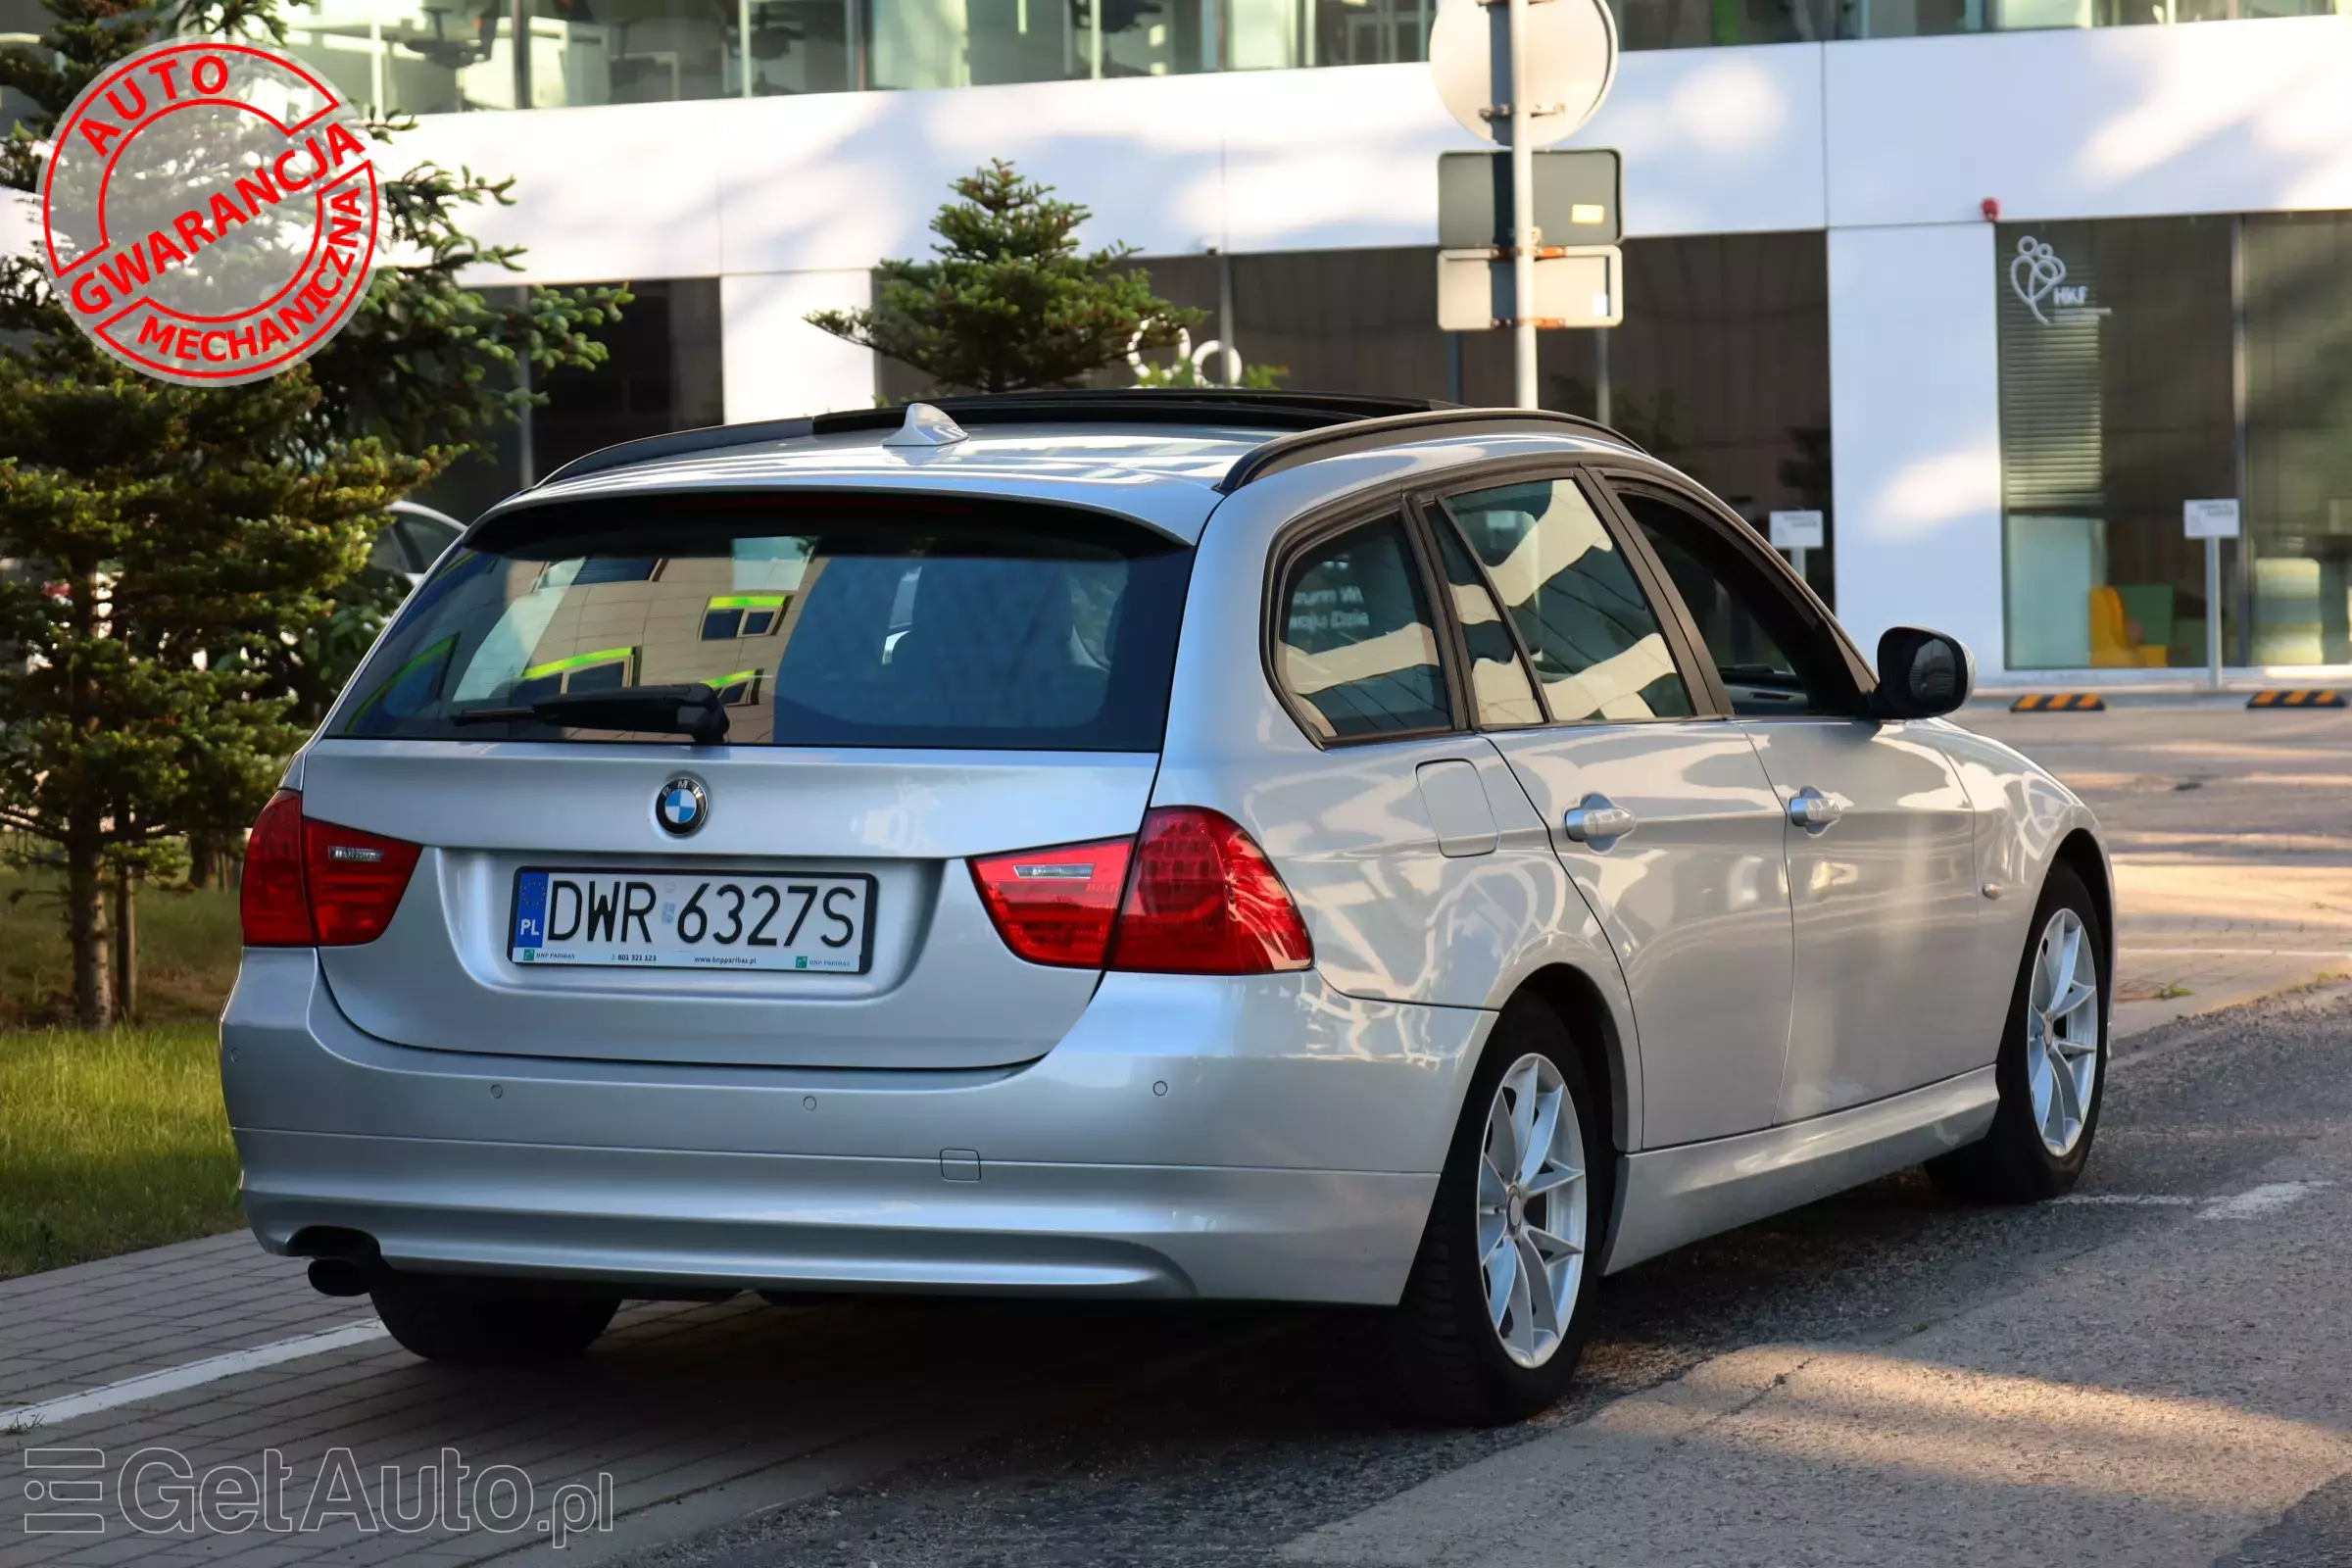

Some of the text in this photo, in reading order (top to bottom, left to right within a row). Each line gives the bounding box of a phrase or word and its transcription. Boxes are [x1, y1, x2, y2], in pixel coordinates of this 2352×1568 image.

[662, 779, 704, 799] BMW
[547, 880, 857, 948] DWR 6327S
[519, 918, 540, 936] PL
[694, 956, 758, 966] www.bnpparibas.pl
